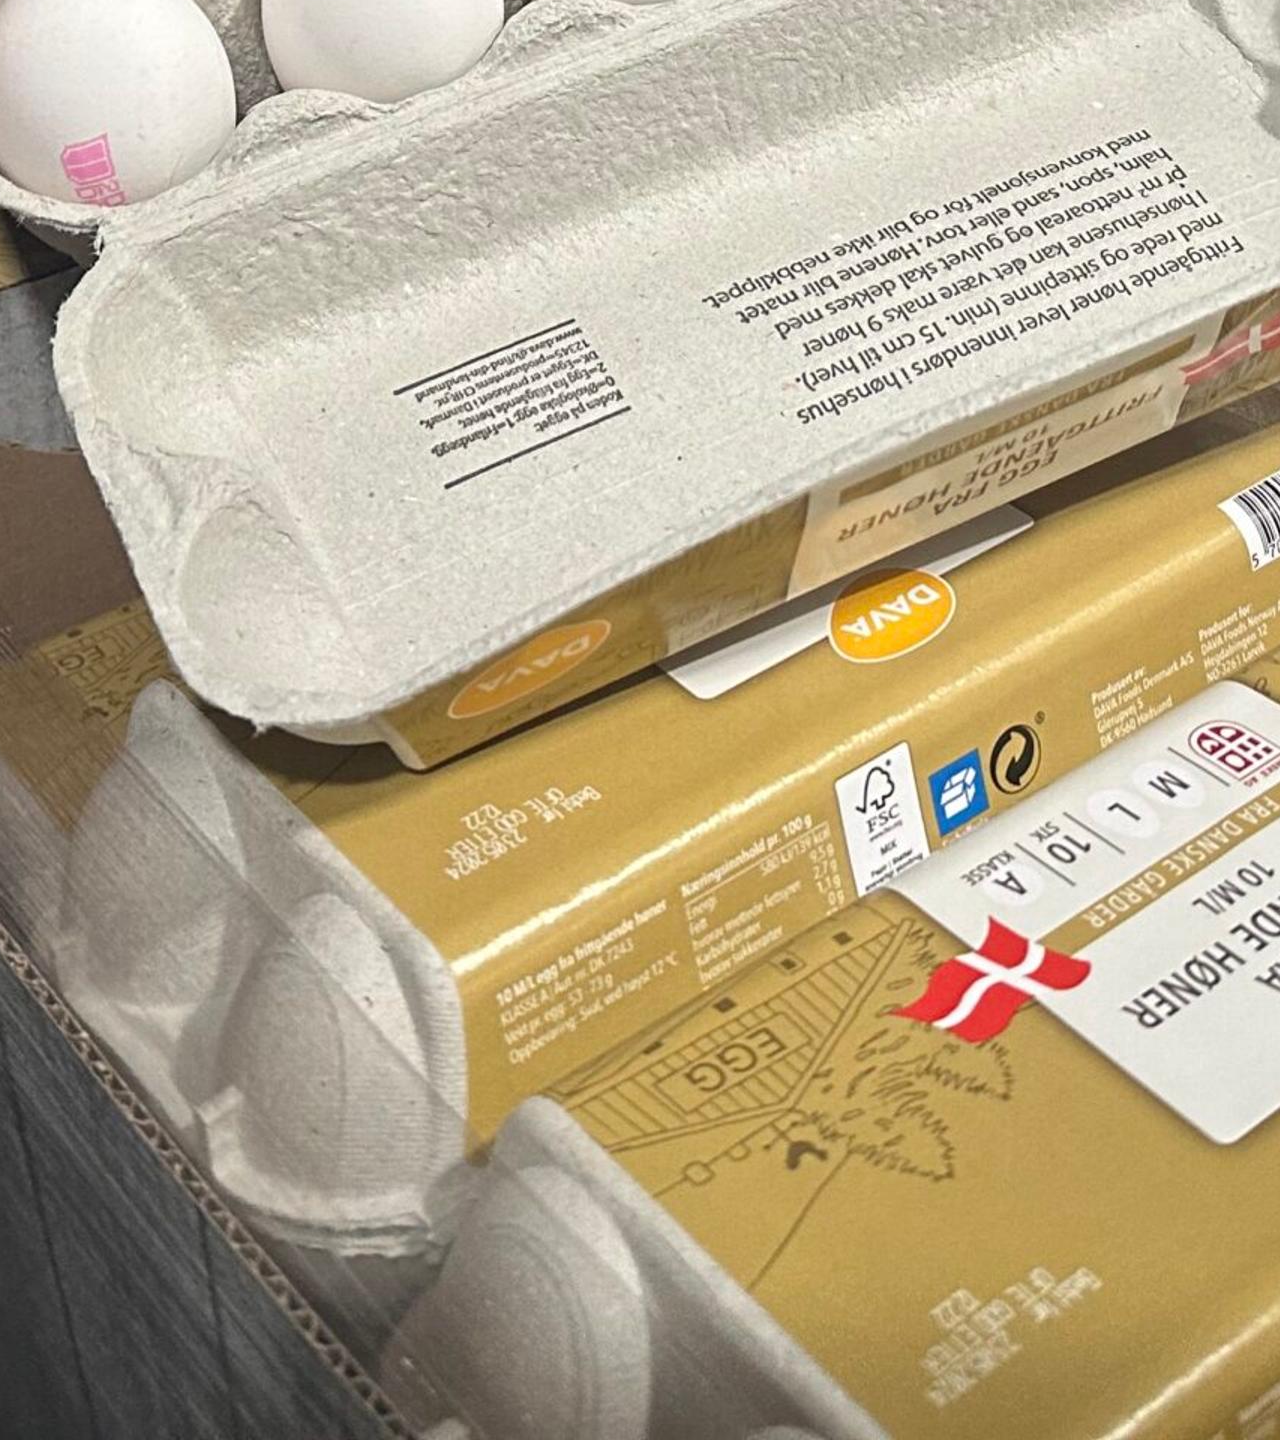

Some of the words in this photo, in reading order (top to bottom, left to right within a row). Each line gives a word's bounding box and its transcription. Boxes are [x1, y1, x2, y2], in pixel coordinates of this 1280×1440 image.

[1106, 129, 1151, 155] med
[1113, 147, 1173, 171] halm,
[971, 146, 1108, 204] konvensjonelt
[1059, 168, 1114, 191] spon,
[1138, 176, 1163, 198] m²
[1165, 164, 1187, 184] pr
[1012, 188, 1060, 216] sand
[1034, 187, 1134, 235] nettoareal
[1195, 190, 1208, 204] I
[877, 220, 913, 241] blir
[909, 210, 939, 226] og
[968, 208, 1011, 231] eller
[1067, 193, 1199, 248] hønsehusene
[1177, 212, 1223, 241] med
[832, 234, 877, 257] ikke
[917, 225, 967, 248] torv.
[1004, 226, 1034, 243] og
[1130, 230, 1177, 255] rede
[837, 243, 920, 281] Hønene
[937, 233, 1004, 271] gulvet
[1028, 242, 1070, 264] kan
[1100, 248, 1129, 267] og
[1129, 236, 1244, 287] Frittgående
[702, 251, 831, 308] nebbklippet.
[898, 262, 938, 290] skal
[990, 258, 1027, 280] det
[1000, 259, 1100, 306] sittepinne
[802, 275, 839, 297] blir
[825, 279, 896, 315] dekkes
[938, 272, 992, 299] være
[1070, 279, 1132, 313] høner
[735, 290, 799, 324] matet
[883, 292, 938, 322] maks
[945, 297, 1000, 325] (min.
[1018, 304, 1071, 334] lever
[774, 308, 824, 340] med
[867, 315, 883, 332] 9
[919, 322, 947, 344] 15
[803, 322, 867, 357] høner
[881, 333, 915, 354] cm
[911, 324, 1018, 376] innendørs
[858, 347, 882, 369] til
[795, 356, 860, 392] hver).
[900, 368, 912, 384] i
[797, 372, 903, 424] hønsehus
[998, 445, 1058, 487] EGG
[934, 481, 989, 516] FRA
[1251, 552, 1260, 569] 5
[840, 584, 941, 642] DAVA
[478, 635, 590, 692] DAVA
[1149, 771, 1189, 798] M
[867, 803, 900, 833] FSC
[1108, 803, 1140, 821] L
[1237, 796, 1280, 824] FRA
[1030, 821, 1060, 843] STK
[1162, 815, 1243, 876] DANSKE
[1047, 835, 1091, 864] 10
[961, 850, 1015, 886] KLASSE
[1237, 861, 1275, 887] 10
[994, 871, 1027, 895] A
[1082, 871, 1166, 928] GÅRDER
[1192, 880, 1246, 915] M/L
[1122, 942, 1246, 1028] HØNER
[685, 1026, 788, 1093] EGG
